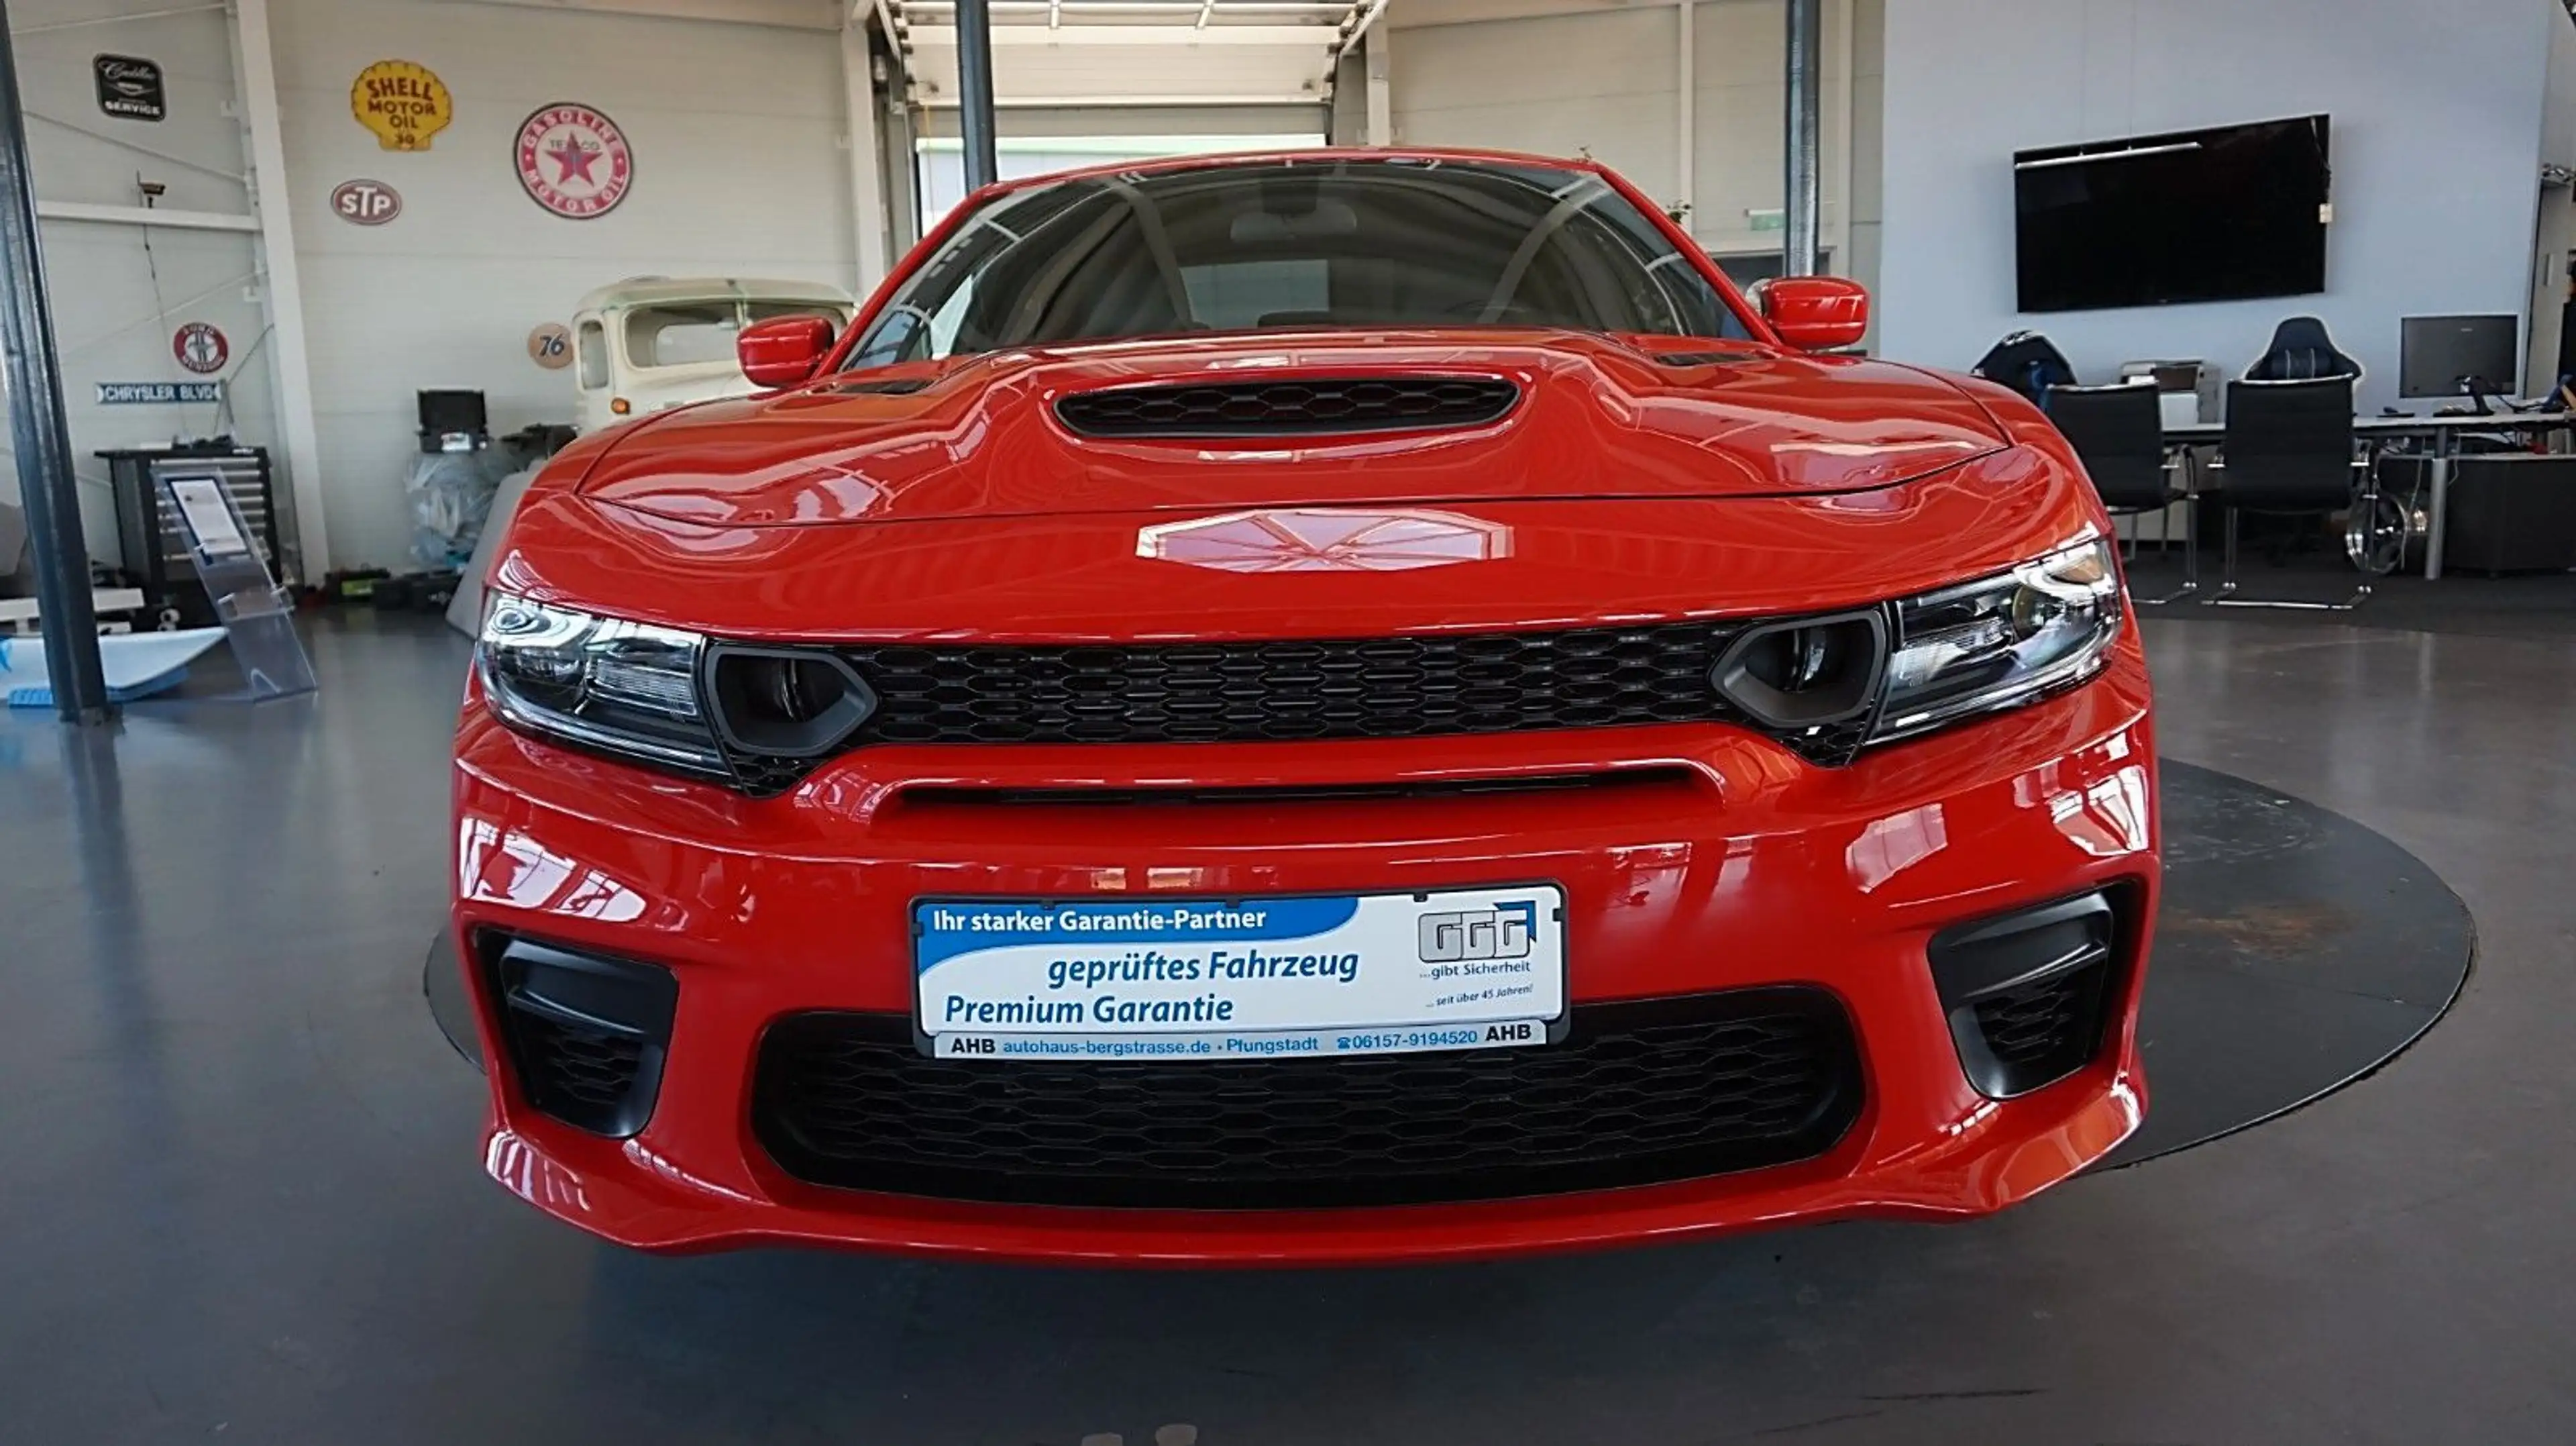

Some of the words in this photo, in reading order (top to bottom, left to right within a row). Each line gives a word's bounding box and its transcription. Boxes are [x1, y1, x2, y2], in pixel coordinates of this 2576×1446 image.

[366, 77, 433, 101] SHELL
[105, 101, 160, 115] SERVICE
[367, 98, 437, 115] MOTOR
[389, 114, 419, 129] OIL
[341, 186, 391, 217] STP
[525, 168, 597, 213] MOTOR
[601, 174, 625, 201] OIL
[539, 333, 565, 356] 76
[105, 385, 175, 401] CHRYSLER
[180, 385, 213, 401] BLVD
[933, 909, 967, 931] Ihr
[971, 909, 1054, 931] starker
[1059, 909, 1267, 931] Garantie-Partner
[1048, 951, 1200, 989] geprüftes
[1209, 948, 1359, 983] Fahrzeug
[1463, 961, 1530, 976] Sicherheit
[1456, 992, 1479, 1003] über
[1481, 989, 1494, 1000] 45
[1496, 983, 1534, 998] Jahren!
[945, 994, 1083, 1023] Premium
[1093, 993, 1234, 1023] Garantie
[951, 1037, 996, 1054] AHB
[1003, 1039, 1211, 1057] autohaus-bergstrasse.de
[1352, 1030, 1478, 1049] 06157-9194520
[1485, 1023, 1532, 1041] AHB
